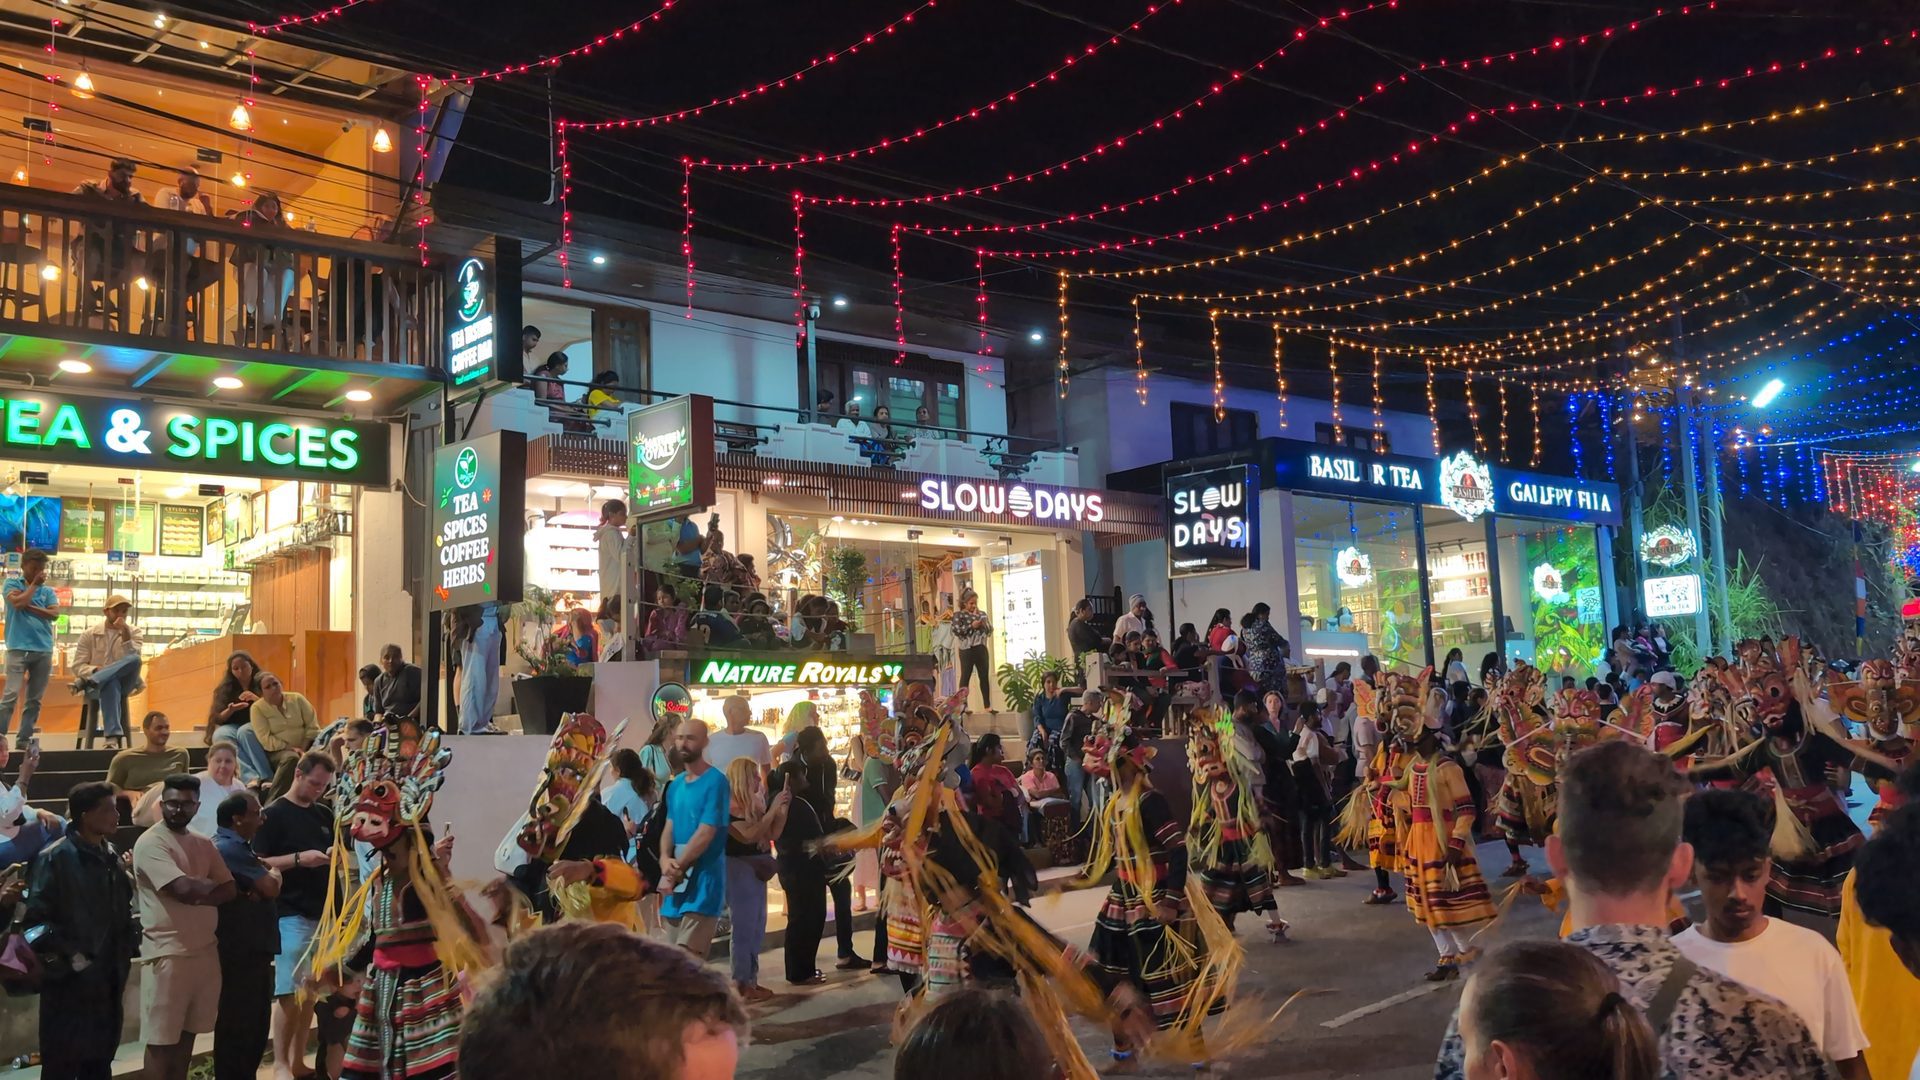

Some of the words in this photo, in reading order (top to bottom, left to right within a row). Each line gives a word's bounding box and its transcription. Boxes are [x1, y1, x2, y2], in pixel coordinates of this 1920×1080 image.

[0, 398, 92, 450] EA
[104, 408, 152, 454] &
[166, 413, 360, 471] SPICES
[453, 491, 479, 515] TEA
[920, 479, 1005, 515] SLOW
[1034, 489, 1104, 522] DAYS
[1173, 482, 1242, 515] SLOW
[443, 512, 488, 543] SPICES
[1174, 516, 1242, 547] DAYS
[440, 536, 490, 566] COFFEE
[442, 562, 486, 590] HERBS
[699, 661, 796, 684] NATURE
[797, 661, 885, 684] ROYALS
